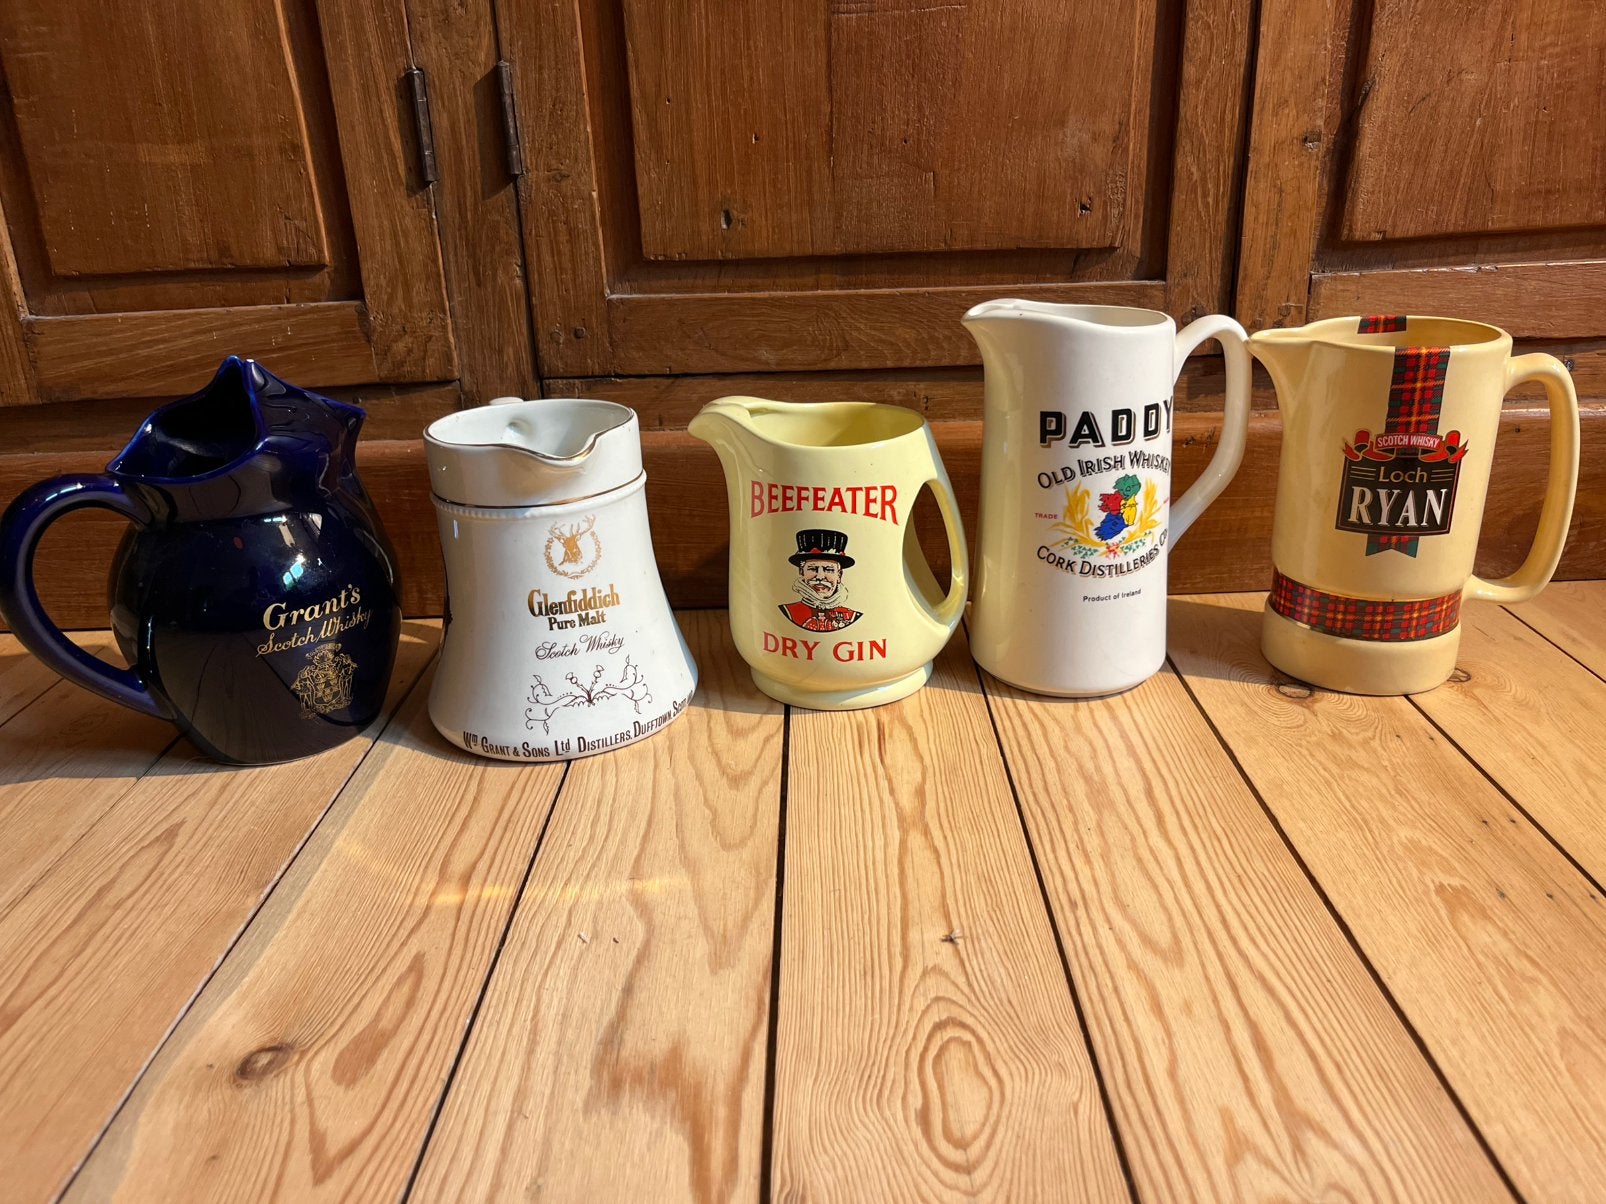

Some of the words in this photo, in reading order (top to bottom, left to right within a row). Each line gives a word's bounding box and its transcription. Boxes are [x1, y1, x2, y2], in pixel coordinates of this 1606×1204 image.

[1039, 396, 1173, 448] PADDY
[1377, 435, 1409, 447] SCOTCH
[1410, 435, 1441, 448] WHISKY
[1037, 466, 1076, 489] OLD
[1077, 454, 1126, 477] IRISH
[1378, 466, 1428, 483] Loch
[750, 480, 900, 526] BEEFEATER
[1034, 512, 1058, 520] TRADE
[1347, 486, 1449, 527] RYAN
[1037, 545, 1078, 576] CORK
[1079, 543, 1161, 578] DISTILLERIES
[263, 584, 361, 630] Grant's
[527, 584, 621, 617] Glenfiddich
[1082, 594, 1111, 603] Product
[1113, 592, 1120, 600] of
[1121, 588, 1142, 599] Ireland
[255, 627, 315, 657] Scotch
[316, 606, 373, 642] Whisky
[548, 617, 576, 631] Pure
[577, 610, 606, 628] Malt
[535, 641, 580, 660] Scotch
[579, 631, 625, 654] Whisky
[763, 631, 821, 661] DRY
[832, 638, 887, 663] GIN
[481, 736, 511, 757] GRANT
[512, 747, 520, 757] &
[522, 741, 550, 758] SONS
[554, 738, 571, 756] Ltd
